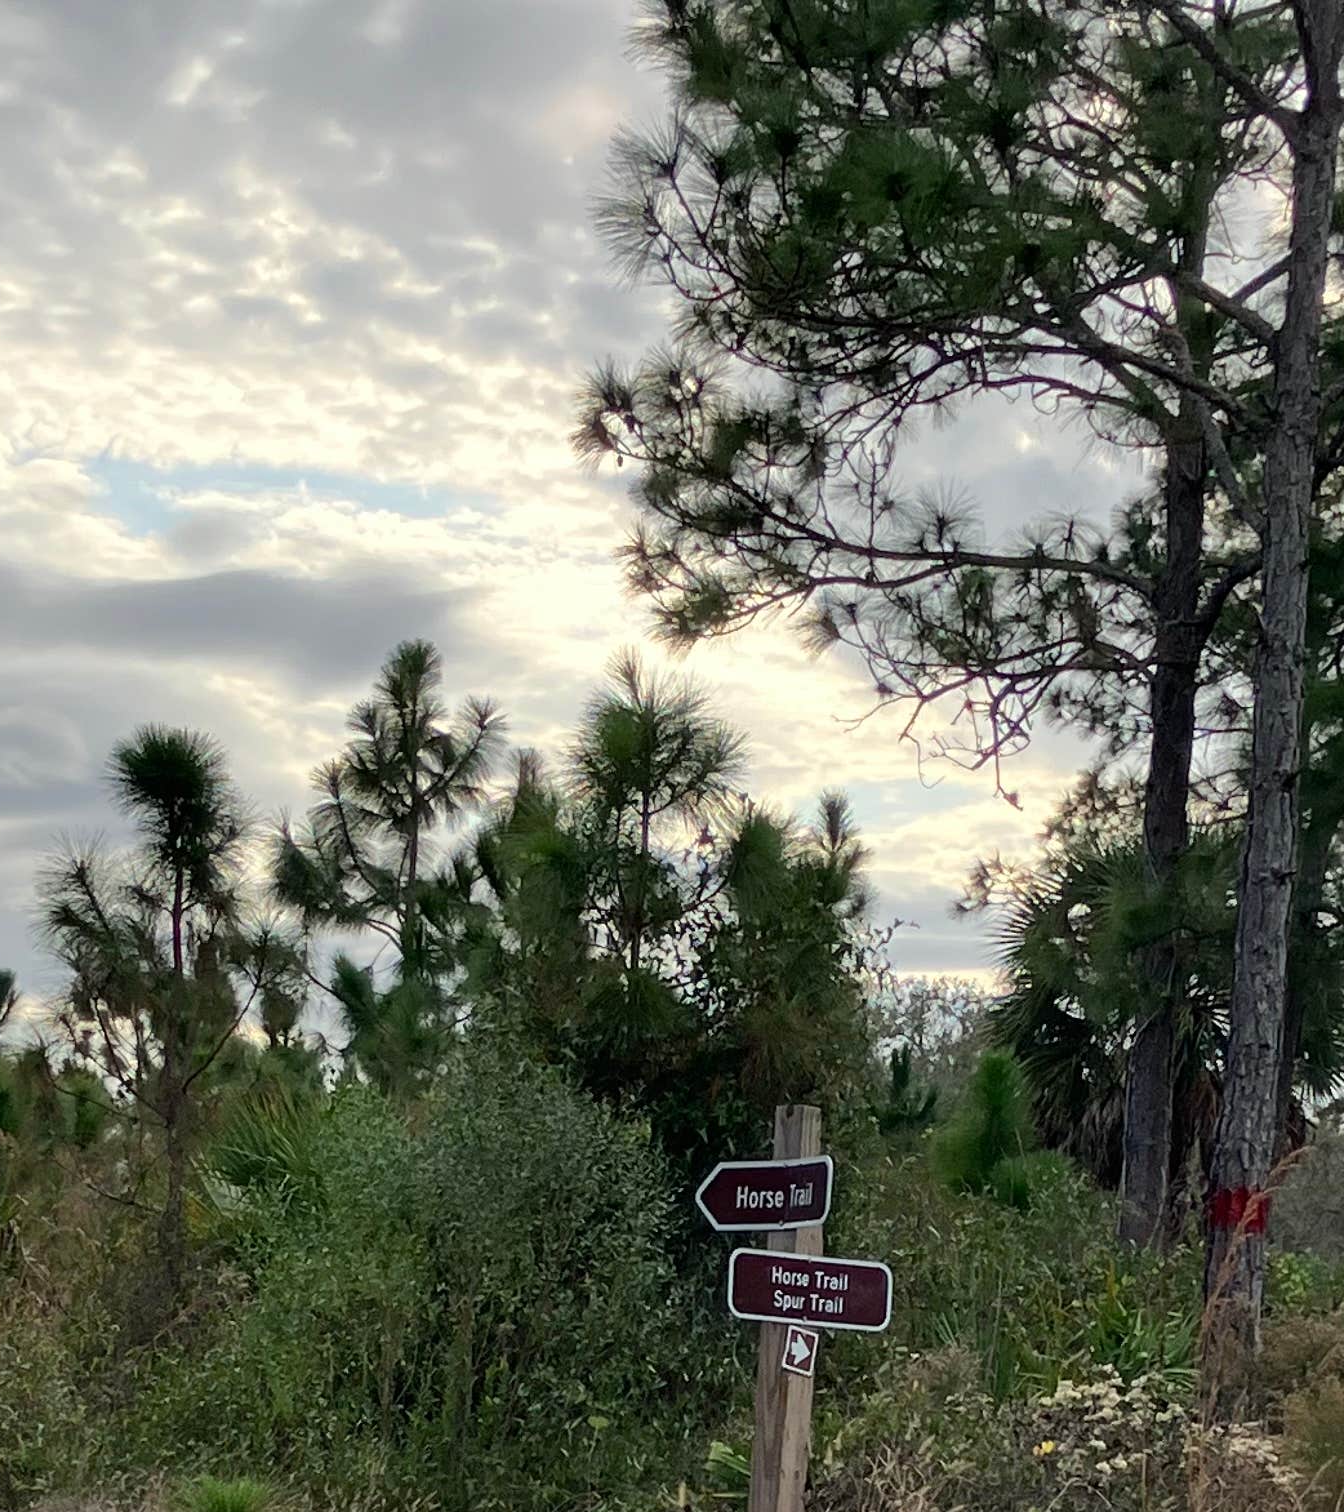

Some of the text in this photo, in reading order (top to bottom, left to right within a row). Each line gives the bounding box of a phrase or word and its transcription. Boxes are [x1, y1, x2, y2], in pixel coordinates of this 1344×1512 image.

[736, 1182, 813, 1208] Horse Trail
[771, 1266, 849, 1291] Horse Trail
[773, 1290, 844, 1314] Spur Trail
